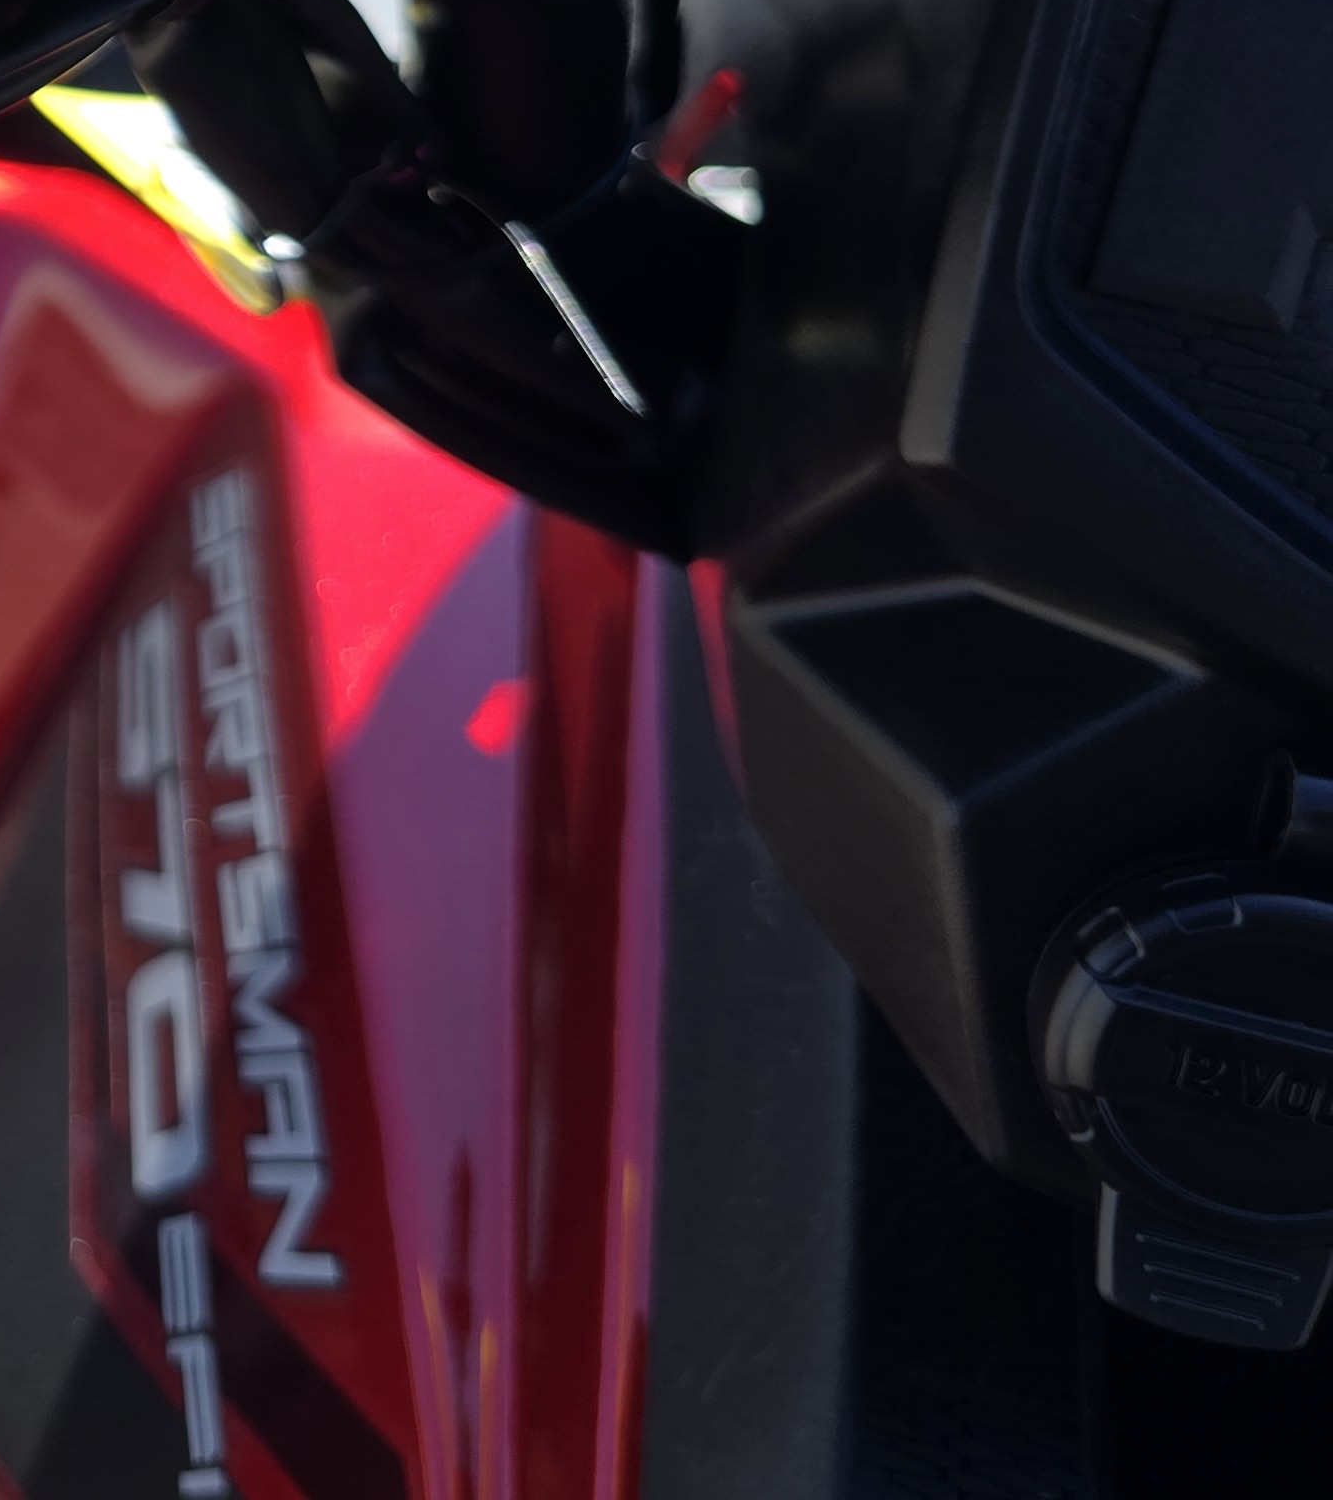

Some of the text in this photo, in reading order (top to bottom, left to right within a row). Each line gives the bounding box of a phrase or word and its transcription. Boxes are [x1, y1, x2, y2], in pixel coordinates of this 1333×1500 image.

[115, 598, 213, 1200] 570
[188, 467, 345, 1291] SPORTSMAN
[1238, 1058, 1333, 1126] VOL
